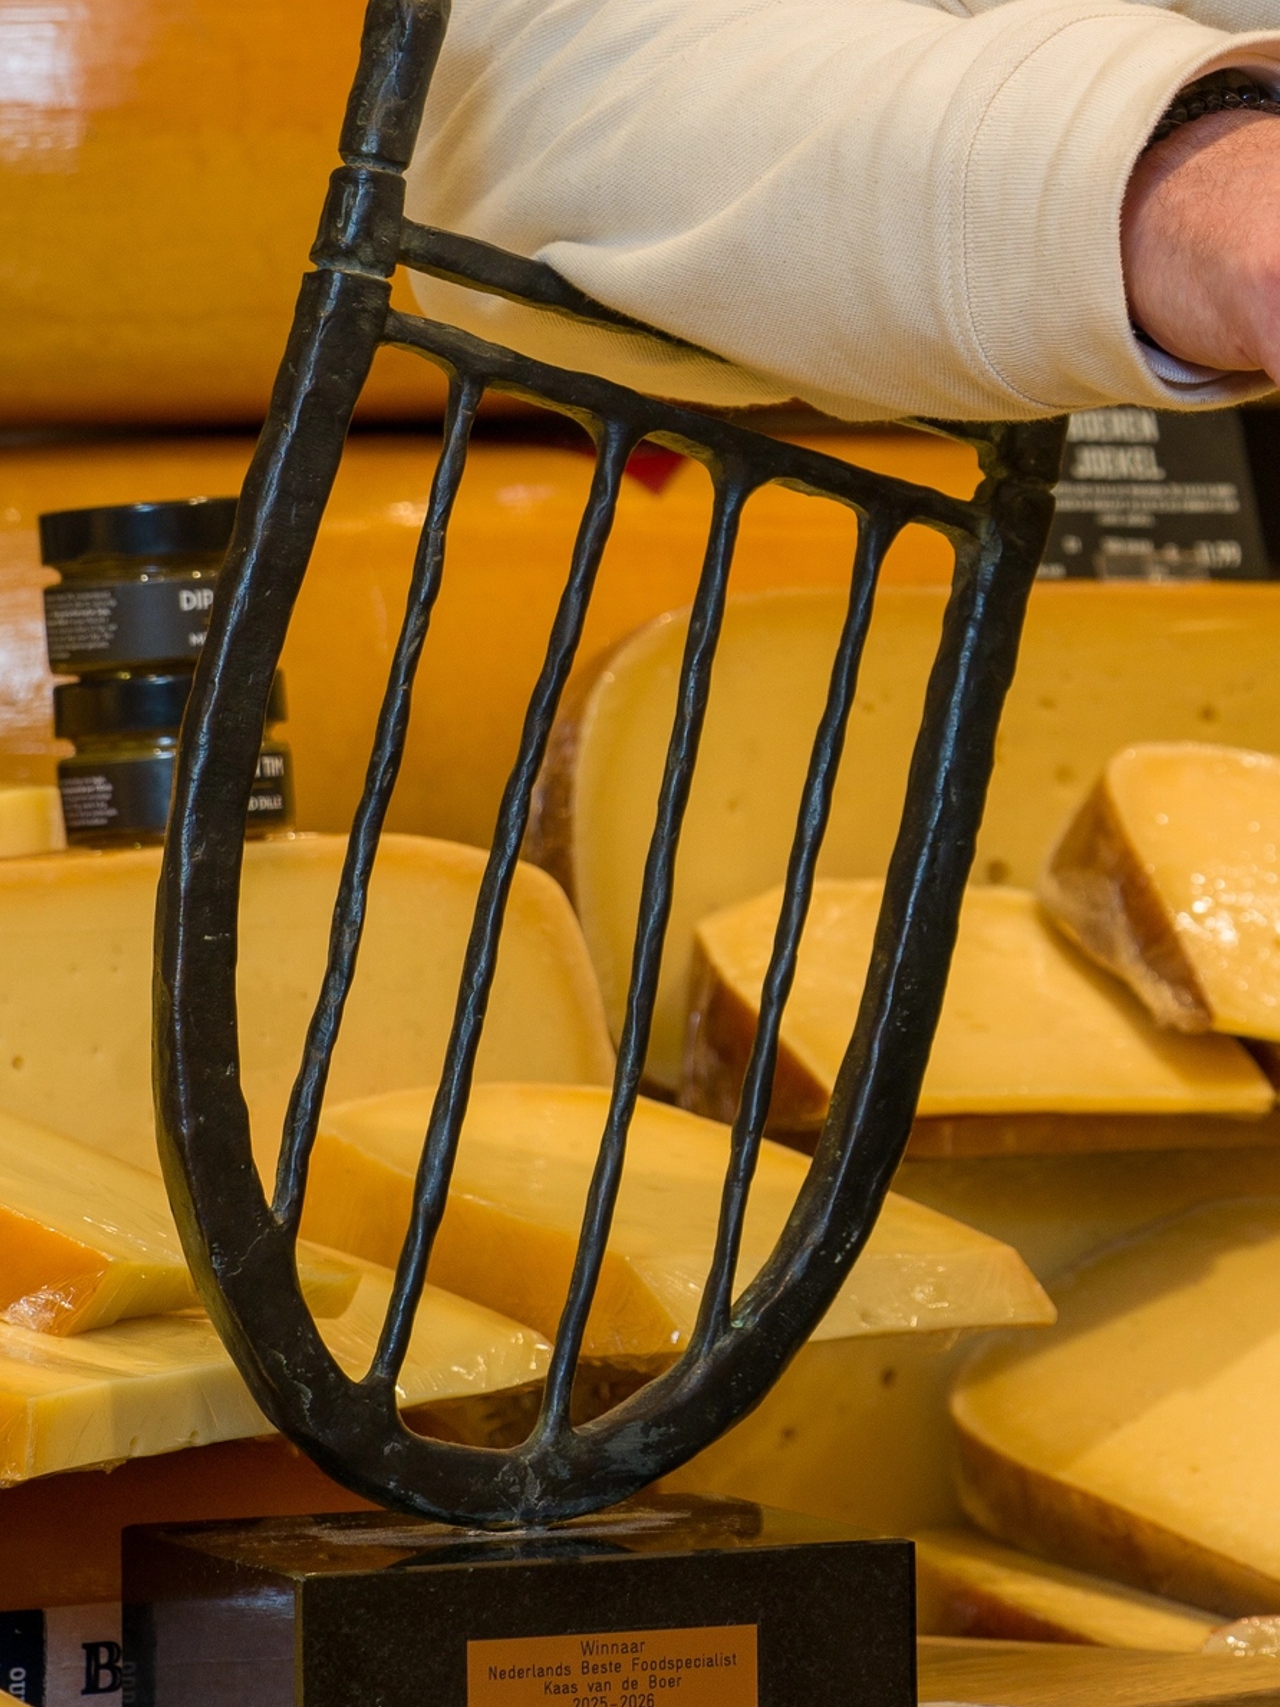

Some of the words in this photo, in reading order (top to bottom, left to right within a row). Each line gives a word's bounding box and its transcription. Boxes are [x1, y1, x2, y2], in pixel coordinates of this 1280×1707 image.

[580, 1640, 646, 1657] Winnaar
[488, 1662, 571, 1680] Nederlands
[581, 1660, 622, 1676] Beste
[631, 1653, 738, 1672] Foodspecialist
[544, 1680, 578, 1695] Kaas
[587, 1681, 612, 1693] van
[622, 1677, 639, 1691] de
[648, 1674, 682, 1690] Boer
[572, 1693, 656, 1707] 2025-2026
